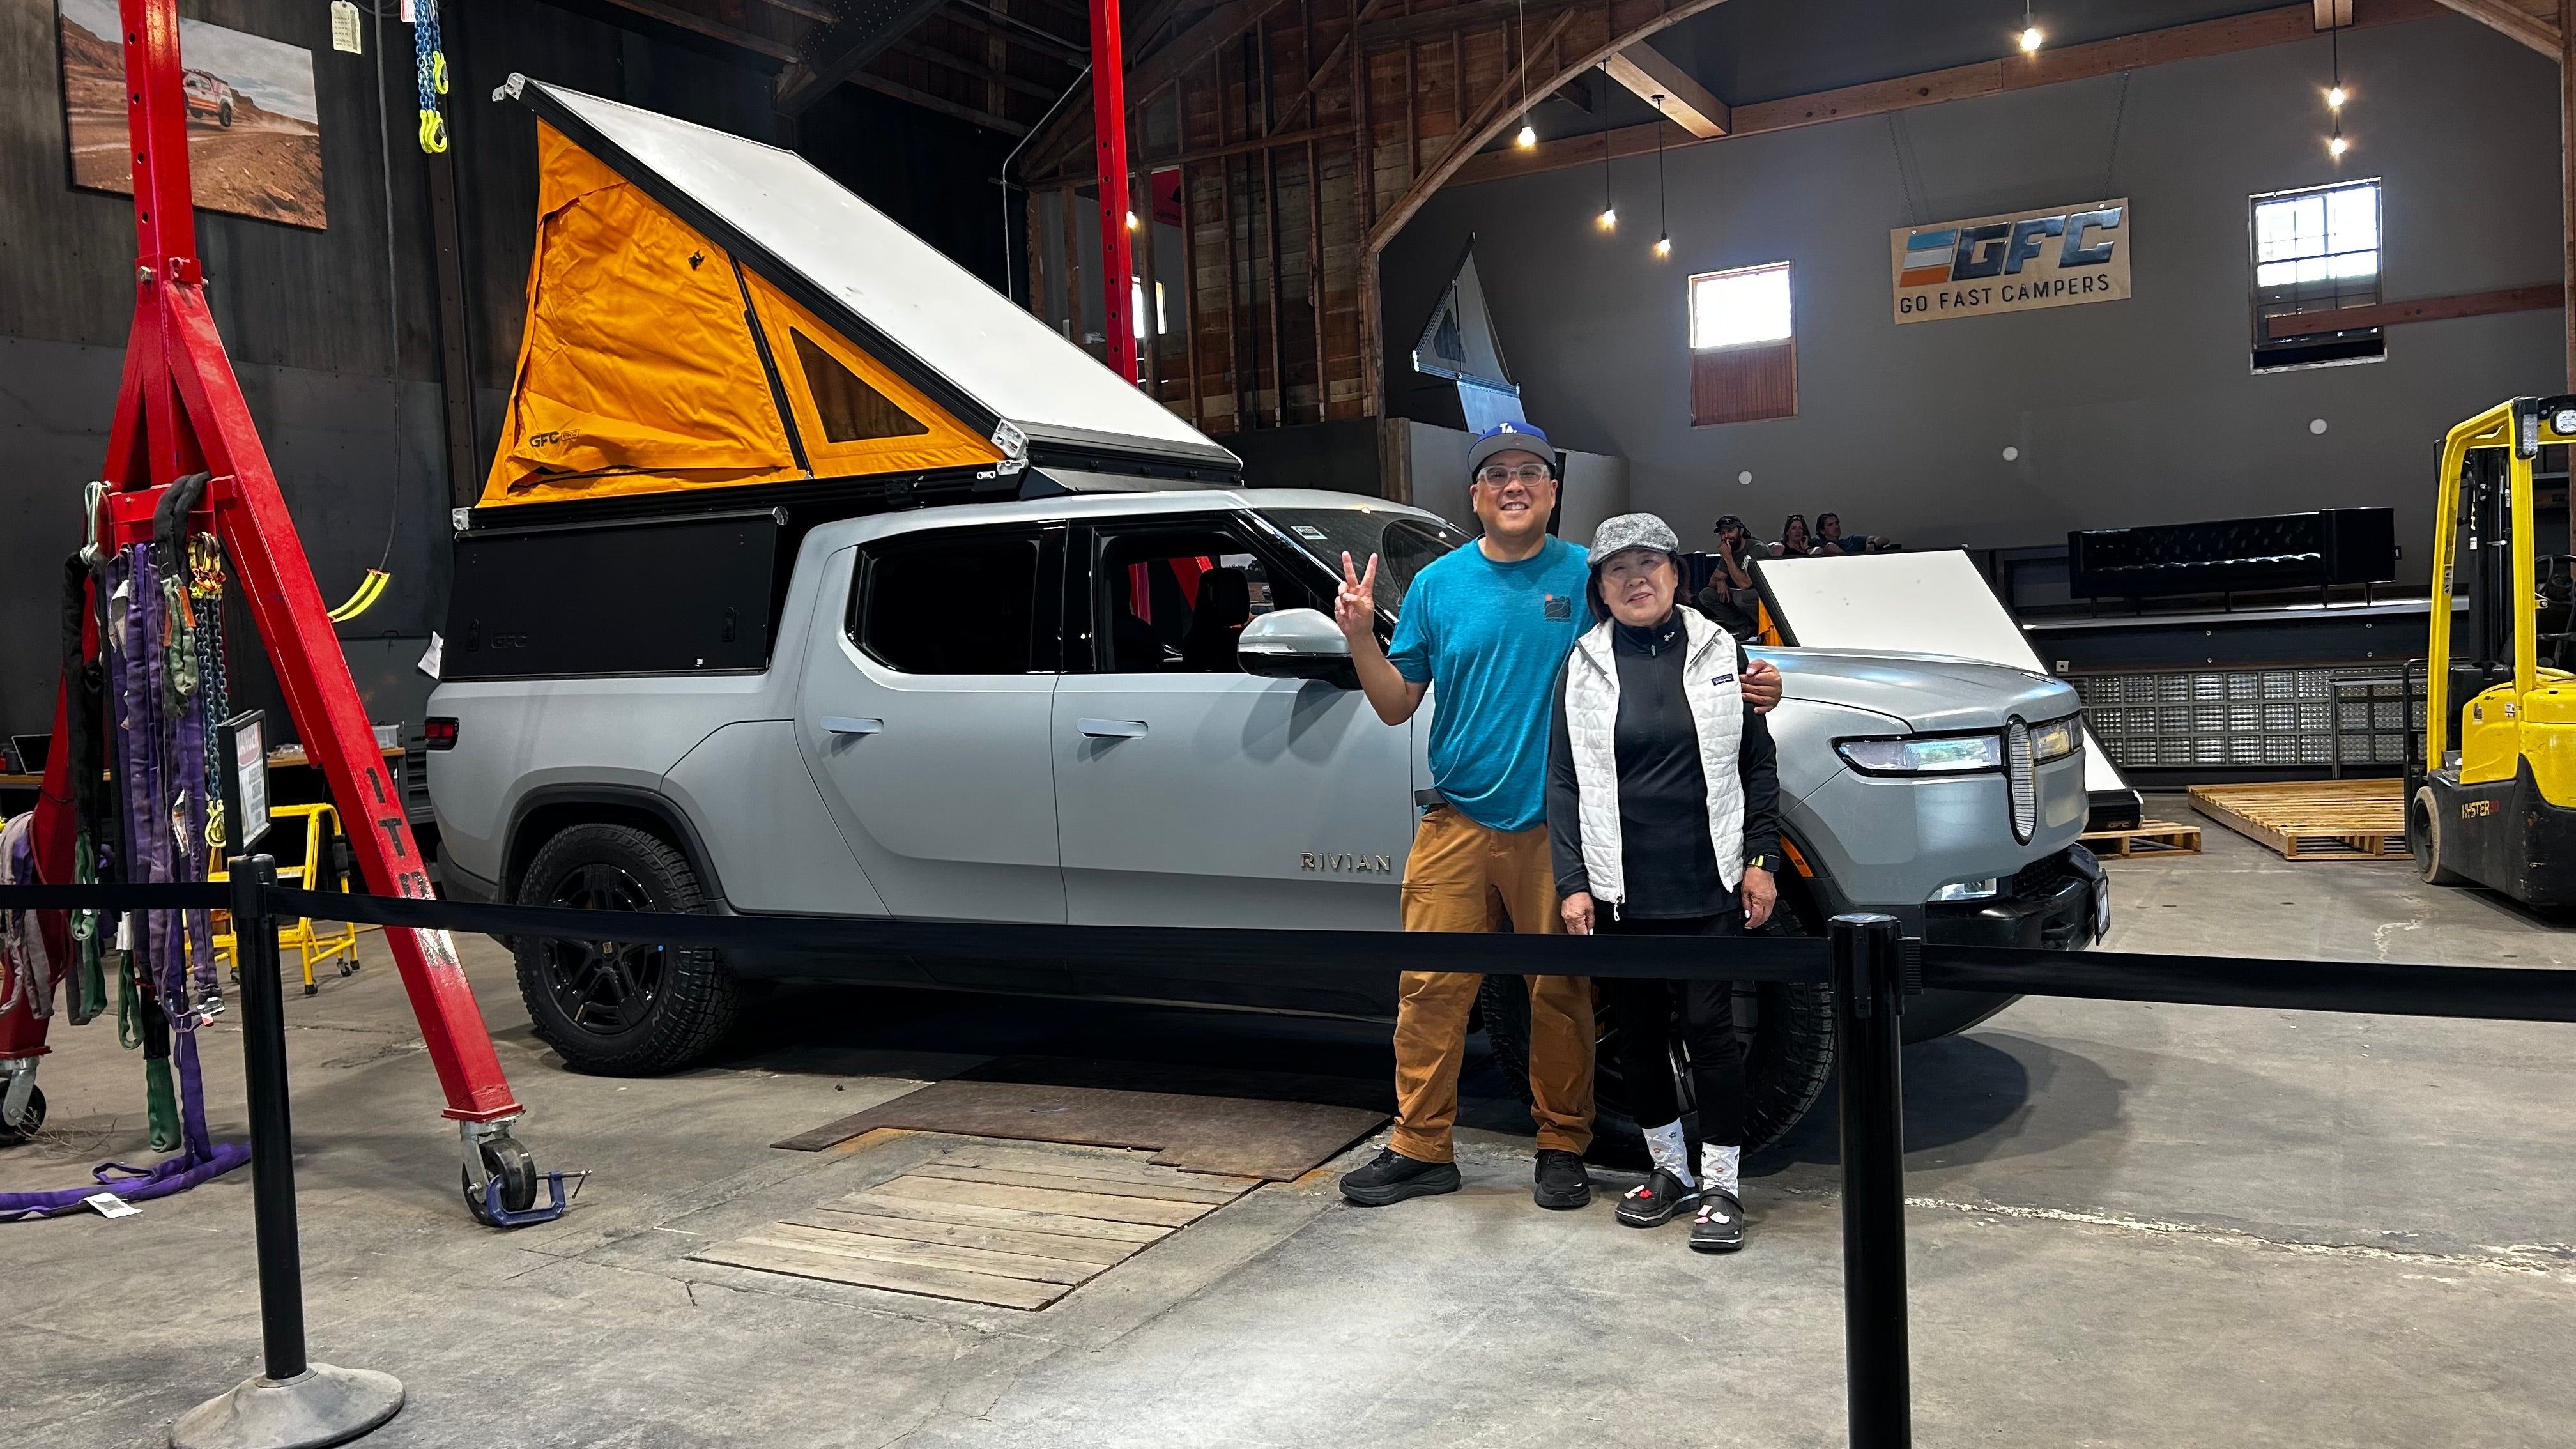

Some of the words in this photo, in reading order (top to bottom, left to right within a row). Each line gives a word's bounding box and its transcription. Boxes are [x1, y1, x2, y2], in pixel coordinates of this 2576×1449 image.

[1952, 206, 2122, 281] GFC
[1900, 296, 1928, 314] GO
[1940, 288, 1991, 309] FAST
[2002, 273, 2110, 302] CAMPERS
[529, 431, 560, 447] GFC
[2462, 800, 2490, 819] HYSTER
[1300, 852, 1391, 871] RIVIAN
